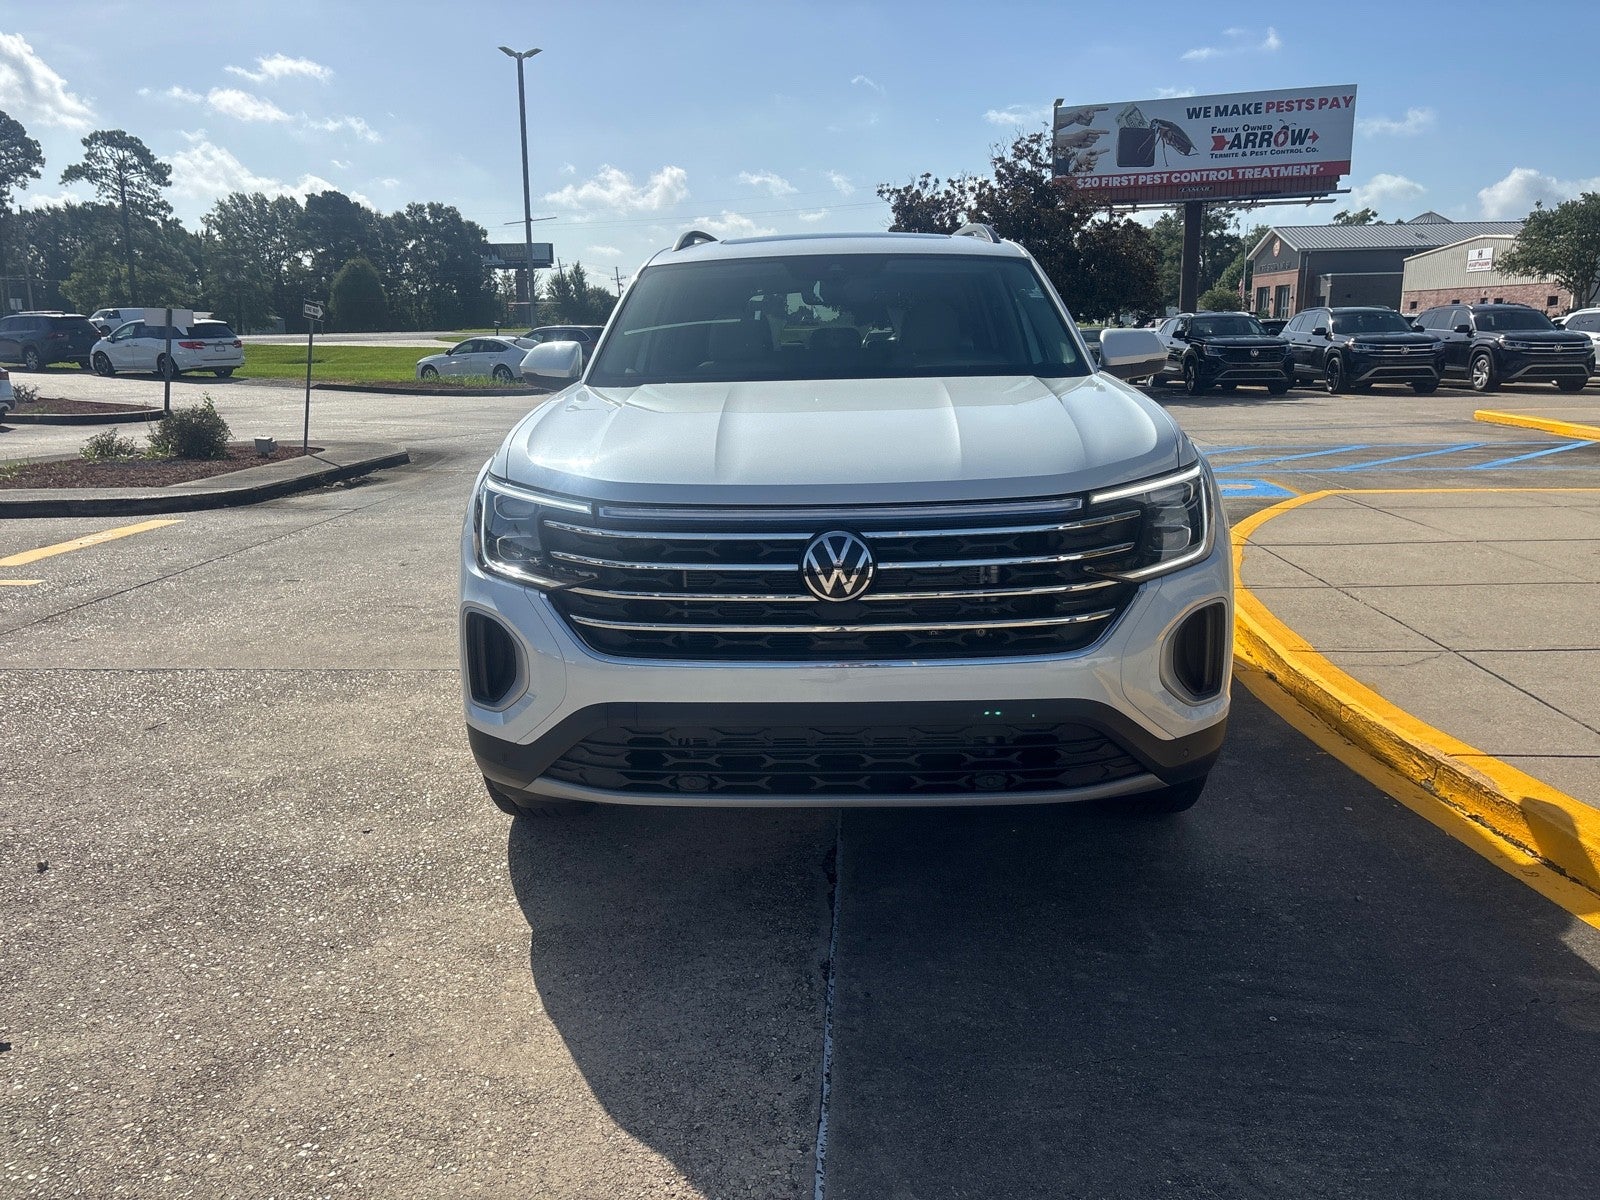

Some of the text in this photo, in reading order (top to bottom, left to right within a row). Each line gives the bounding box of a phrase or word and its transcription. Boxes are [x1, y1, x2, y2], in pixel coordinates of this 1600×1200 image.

[1186, 95, 1354, 120] WE MAKE PESTS PAY
[1228, 127, 1310, 150] ARROW
[1076, 177, 1100, 189] $20
[1101, 175, 1137, 187] FIRST
[1138, 173, 1170, 185] PEST
[1171, 169, 1235, 183] CONTROL
[804, 532, 872, 601] VW
